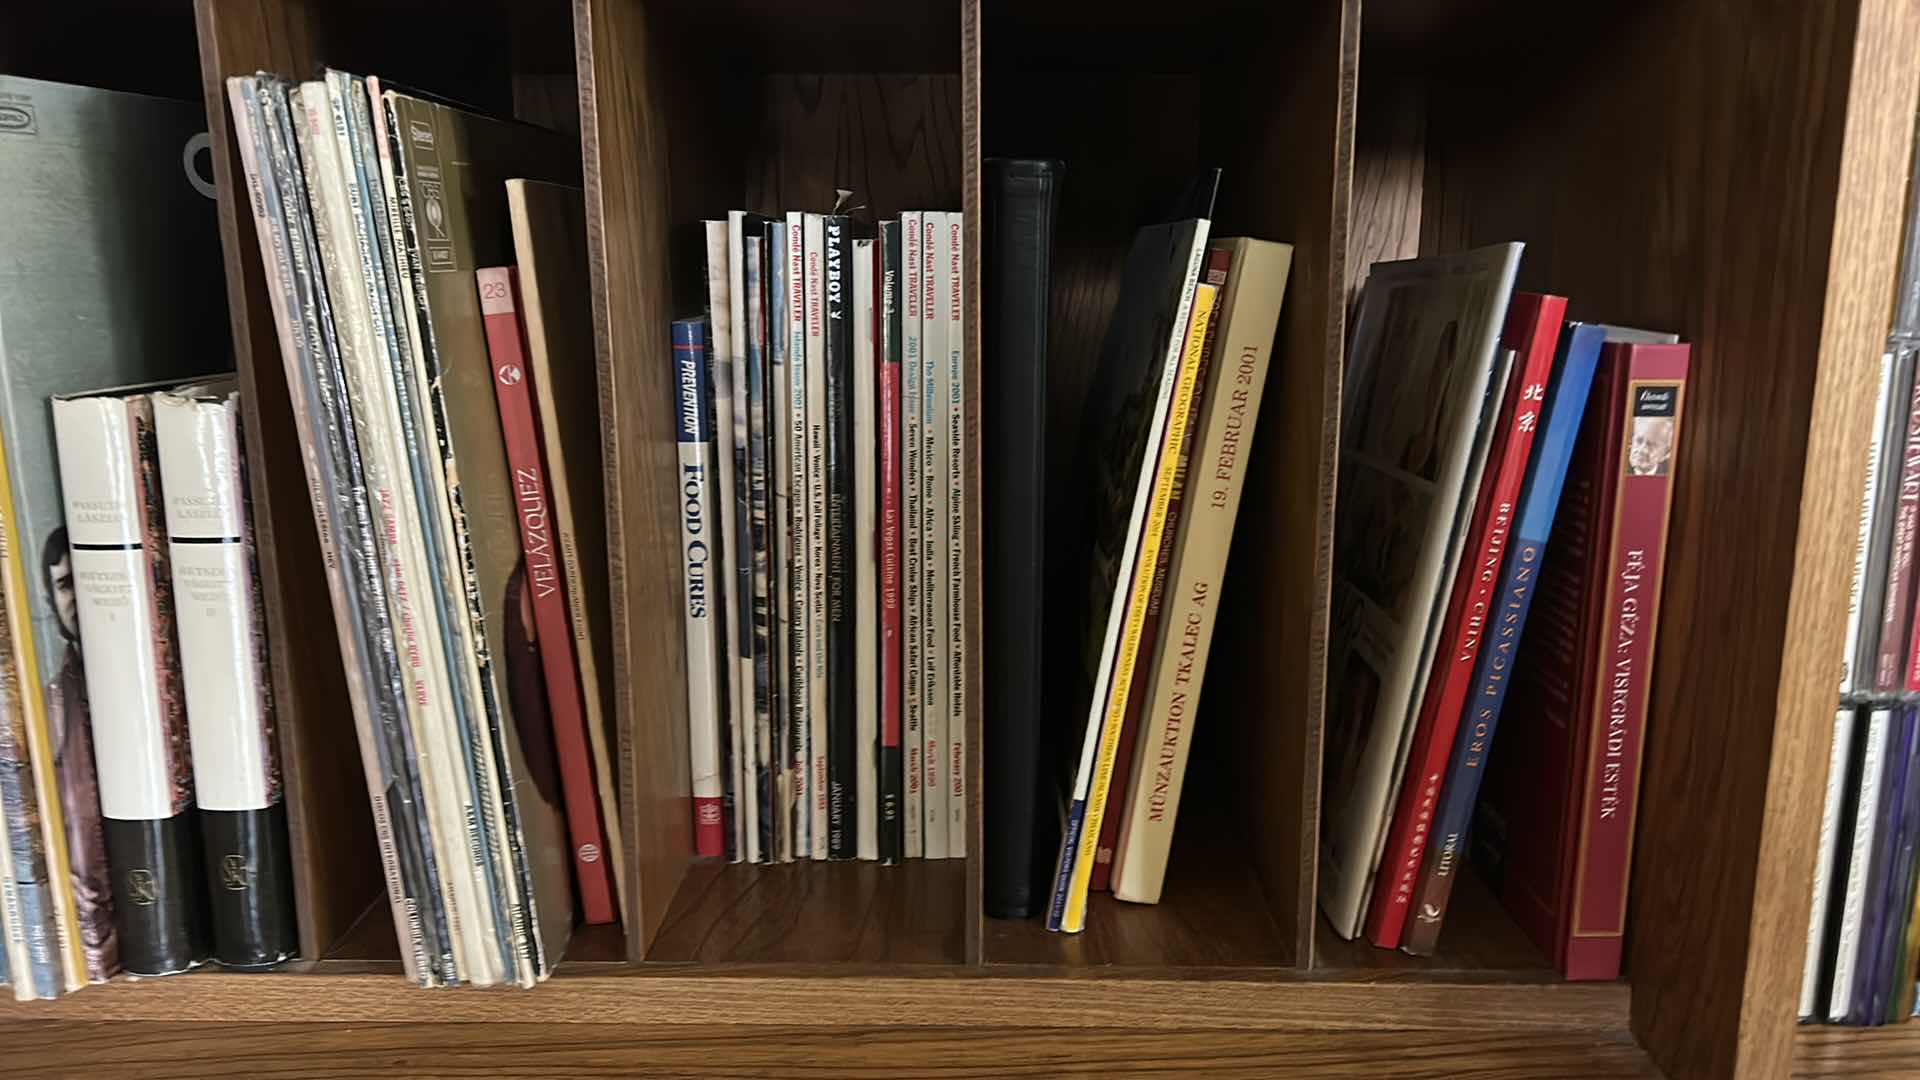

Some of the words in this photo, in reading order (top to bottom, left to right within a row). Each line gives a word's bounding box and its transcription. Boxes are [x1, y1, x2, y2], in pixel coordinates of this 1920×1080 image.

[792, 224, 801, 252] Condé
[908, 219, 918, 248] Condé
[926, 222, 934, 250] Condé
[951, 224, 960, 251] Condé
[393, 237, 412, 279] MATHIEU
[793, 255, 801, 274] Nast
[810, 252, 818, 276] Condé
[828, 225, 841, 303] PLAYBOY
[908, 250, 918, 269] Nast
[926, 252, 934, 272] Nast
[951, 254, 960, 274] Nast
[483, 282, 506, 299] 23
[793, 278, 802, 321] TRAVELER
[885, 270, 895, 304] Volume
[909, 272, 918, 316] TRAVELER
[926, 275, 934, 320] TRAVELER
[952, 276, 960, 321] TRAVELER
[811, 298, 819, 336] TRAVELER
[909, 336, 918, 358] 2001
[1185, 310, 1208, 370] NATIONAL
[950, 350, 960, 380] Europe
[1237, 344, 1259, 382] 2001
[680, 360, 698, 435] PREVENTION
[952, 382, 960, 404] 2001
[794, 420, 802, 431] 50
[1166, 375, 1193, 454] GEOGRAPHIC
[813, 425, 821, 449] Hawaii
[910, 424, 918, 448] Seven
[952, 414, 960, 446] Seaside
[1215, 390, 1249, 482] FEBRUAR
[794, 434, 803, 472] American
[926, 437, 934, 466] Mexico
[952, 448, 960, 478] Resorts
[1901, 423, 1920, 502] STEWART
[910, 450, 918, 485] Wonders
[1169, 453, 1188, 500] MILAN
[683, 463, 704, 534] FOOD
[793, 475, 803, 507] Escapes
[926, 476, 934, 498] Rome
[952, 488, 961, 514] Alpine
[1211, 484, 1229, 510] 19.
[814, 501, 822, 513] Fall
[886, 509, 896, 524] Las
[910, 494, 918, 528] Thailand
[926, 508, 934, 531] Africa
[516, 467, 553, 599] VELÁZQUEZ
[794, 517, 803, 556] Rodrigues
[814, 515, 822, 540] Foliage
[831, 493, 841, 574] ENTERTAINMENT
[884, 526, 896, 550] Vegas
[952, 516, 961, 540] Skiing
[815, 546, 823, 567] Korea
[910, 538, 918, 555] Best
[926, 540, 934, 560] India
[1481, 502, 1512, 583] BEIJING
[886, 553, 896, 584] Cuisine
[910, 558, 918, 583] Cruise
[952, 549, 961, 576] French
[1620, 549, 1645, 594] FÉJA
[684, 540, 709, 618] CURES
[794, 565, 802, 591] Venice
[815, 573, 823, 590] Nova
[832, 577, 842, 596] FOR
[908, 585, 918, 606] Ships
[926, 570, 935, 627] Mediterranean
[952, 578, 961, 622] Farmhouse
[793, 600, 803, 627] Canary
[832, 600, 842, 622] MEN
[910, 616, 918, 643] African
[926, 629, 935, 648] Food
[952, 624, 961, 642] Food
[1459, 600, 1486, 663] CHINA
[1616, 598, 1640, 654] GÉZA:
[794, 629, 804, 656] Islands
[910, 645, 918, 668] Safari
[926, 656, 935, 672] Leif
[1467, 708, 1492, 769] EROS
[1485, 545, 1537, 697] PICASSIANO
[953, 693, 962, 717] Hotels
[1148, 692, 1187, 823] MÜNZAUKTION
[1175, 612, 1202, 686] TKALEC
[1196, 581, 1209, 608] AG
[1606, 658, 1632, 758] VISEGRÁDI
[910, 704, 918, 731] Seattle
[831, 781, 842, 825] JANUARY
[1599, 763, 1621, 820] ESTÉK
[403, 896, 424, 943] COLUMBIA
